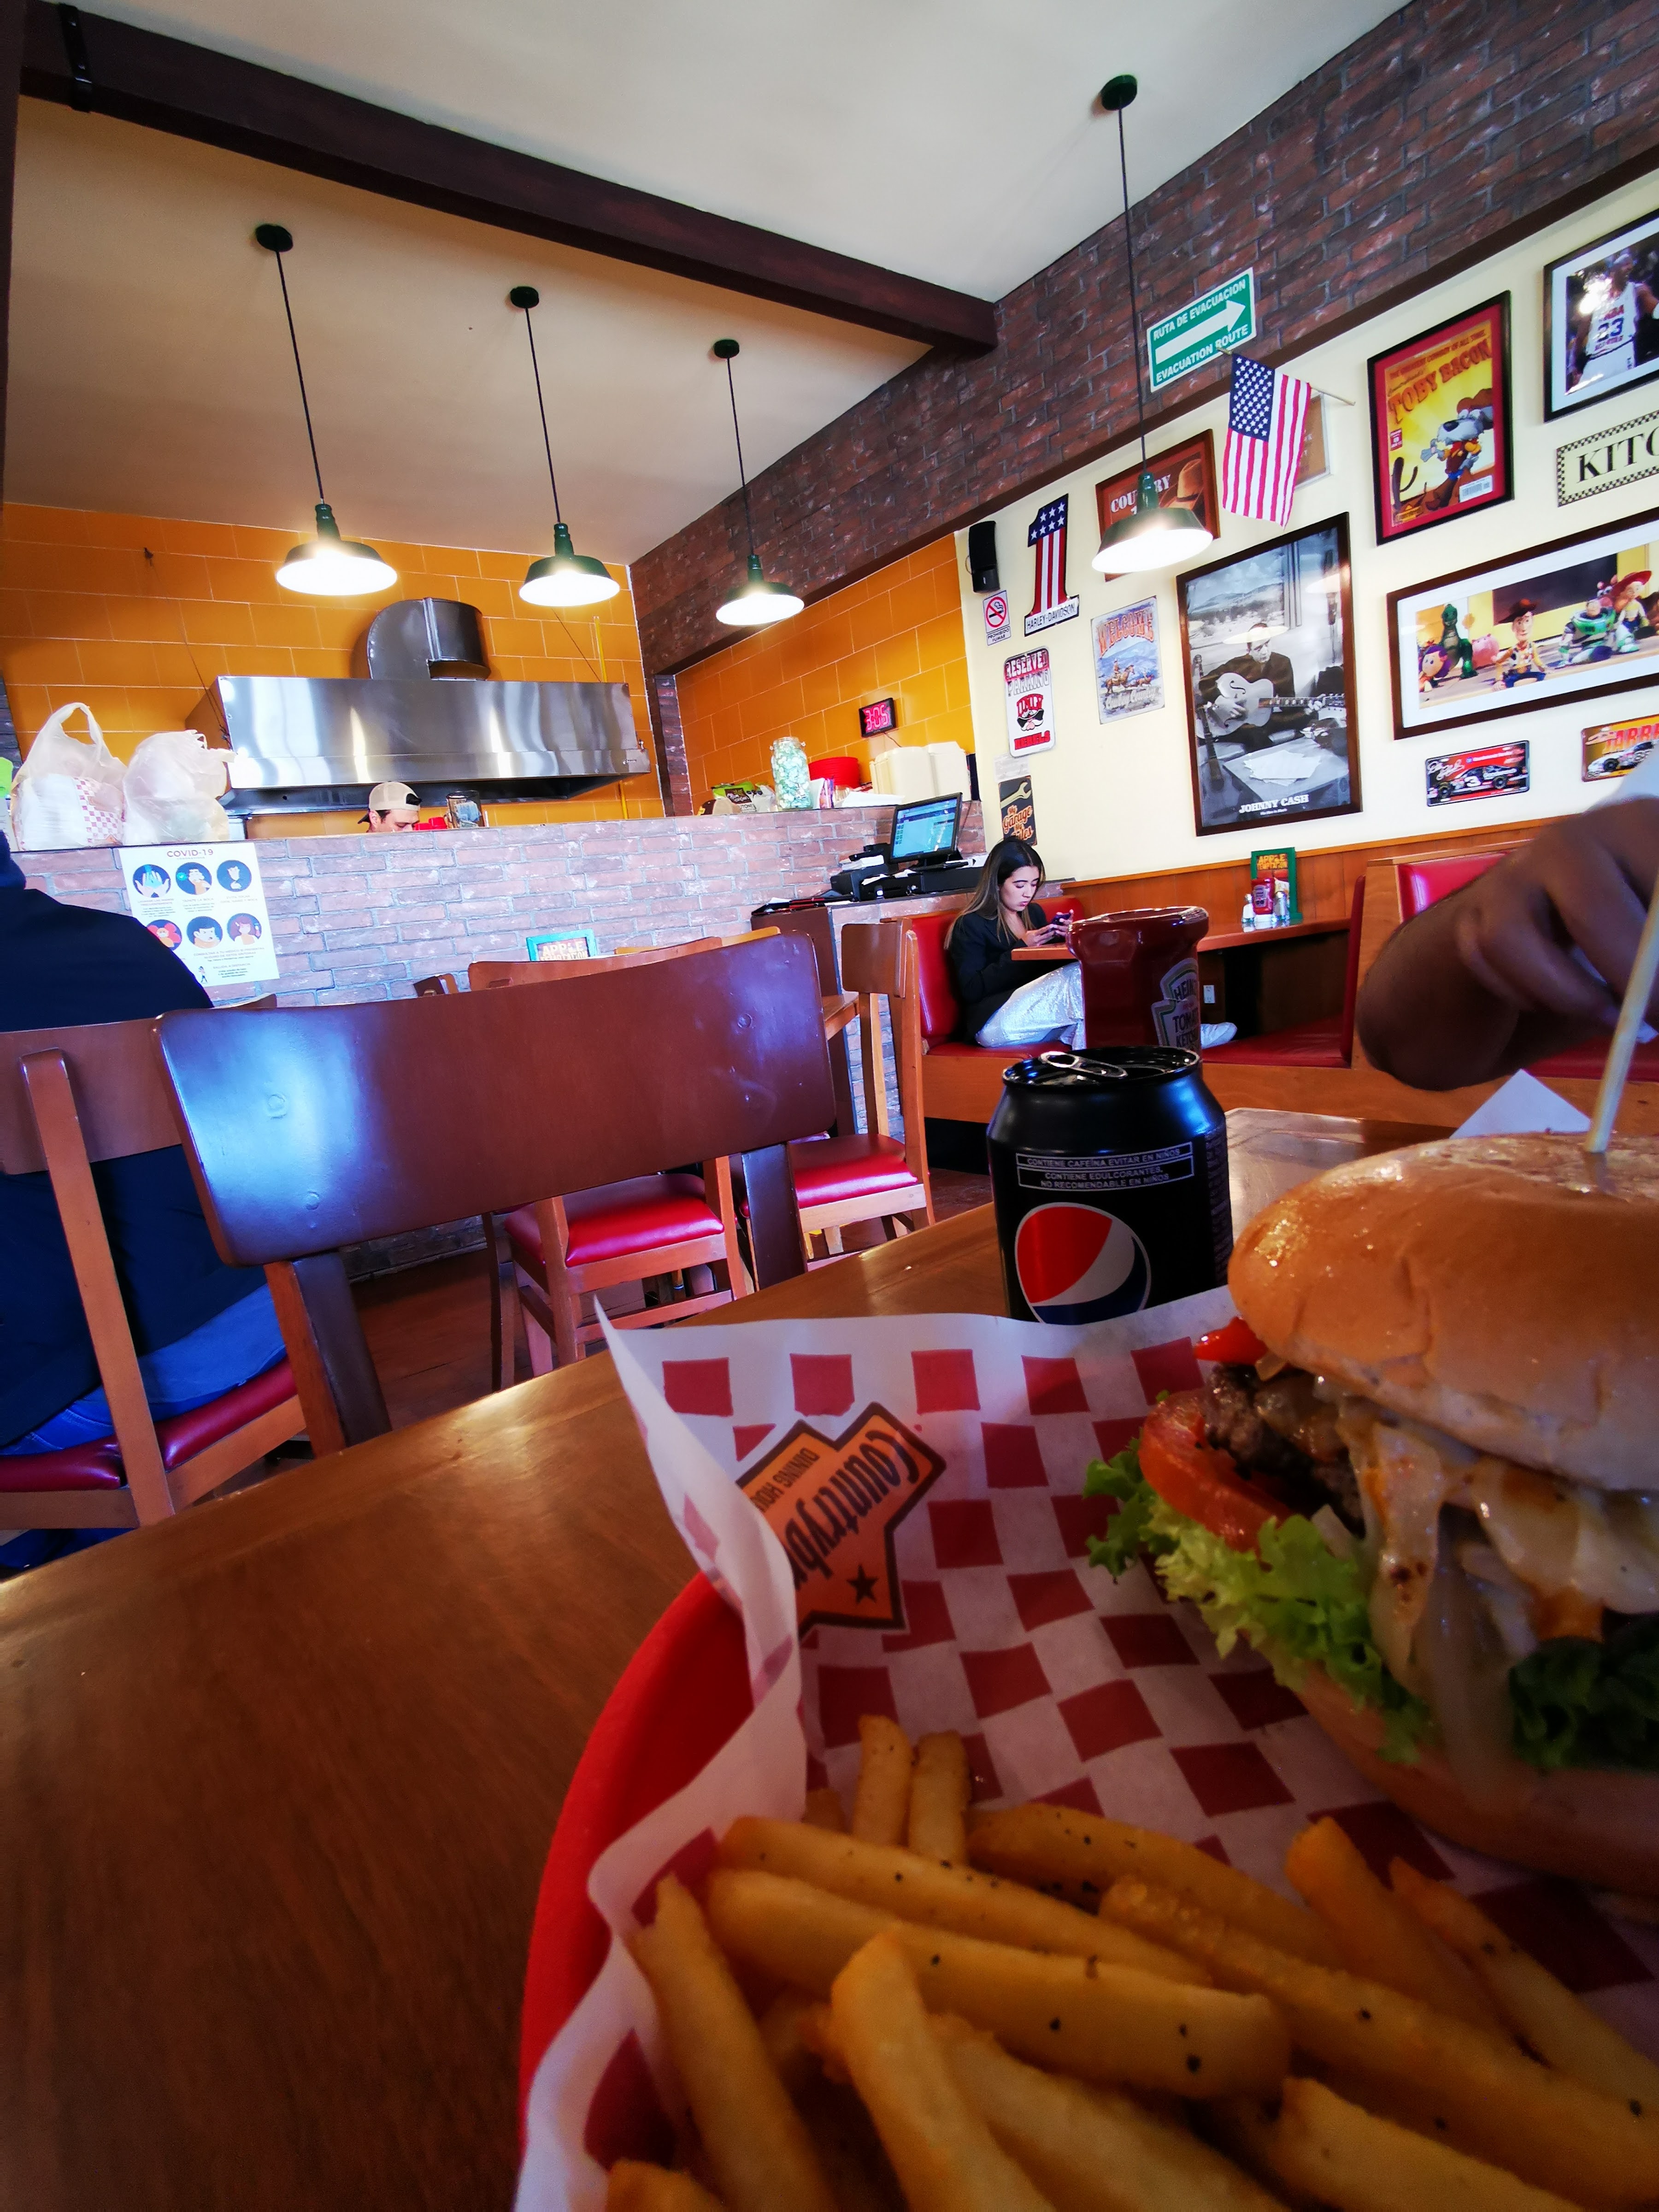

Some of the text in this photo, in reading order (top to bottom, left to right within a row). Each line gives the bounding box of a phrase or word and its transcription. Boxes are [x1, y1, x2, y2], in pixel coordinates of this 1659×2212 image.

[1153, 278, 1246, 341] RUTA DE EVACUACION
[1597, 317, 1624, 343] 23
[1156, 324, 1248, 383] EVACUATION ROUTE
[1388, 371, 1438, 424] TOBY
[1439, 338, 1492, 383] BACON
[1110, 474, 1171, 512] COURY
[1027, 602, 1076, 630] HARLEY-DAVIDSON
[988, 628, 1009, 639] PROHIBIDO
[993, 634, 1006, 642] FUMAR
[1097, 609, 1154, 659] WELCOME
[1006, 649, 1049, 679] RESERVED
[1007, 669, 1050, 697] PARKING
[865, 704, 888, 730] 3:05
[1014, 730, 1051, 750] REBELS
[1464, 776, 1481, 788] 3
[1239, 794, 1309, 813] JOHNNY CASH
[1003, 806, 1033, 834] Garage
[167, 849, 213, 857] COVID-19
[542, 941, 584, 957] APPLE
[1027, 1158, 1065, 1168] CONTIENE
[1108, 1156, 1140, 1166] EVITAR
[1142, 1154, 1154, 1162] EN
[1155, 1148, 1180, 1159] NIÑOS
[1053, 1179, 1127, 1189] RECOMENDABLE
[1129, 1178, 1141, 1186] EN
[1143, 1173, 1169, 1184] NIÑOS
[773, 1447, 820, 1488] DINING
